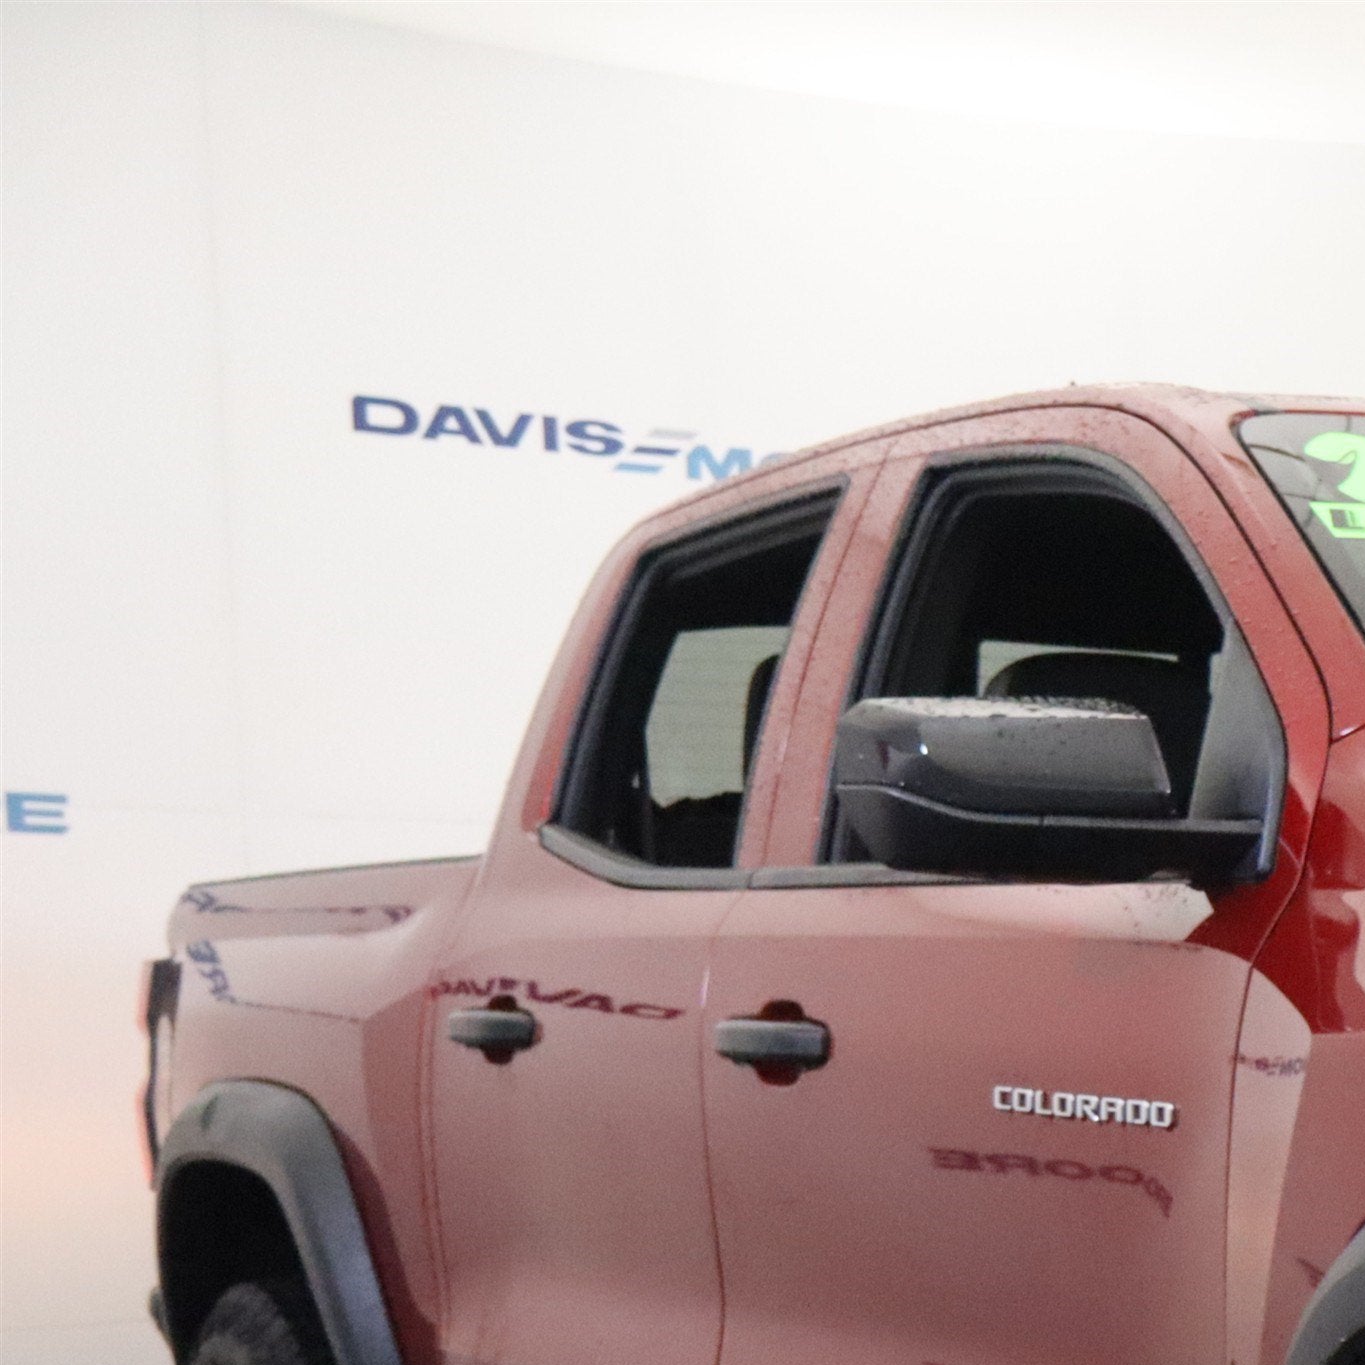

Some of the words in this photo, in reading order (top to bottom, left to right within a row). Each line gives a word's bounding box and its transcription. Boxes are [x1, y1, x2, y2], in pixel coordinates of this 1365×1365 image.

[352, 395, 625, 456] DAVIS
[687, 445, 792, 482] M
[993, 1084, 1176, 1129] COLORADO
